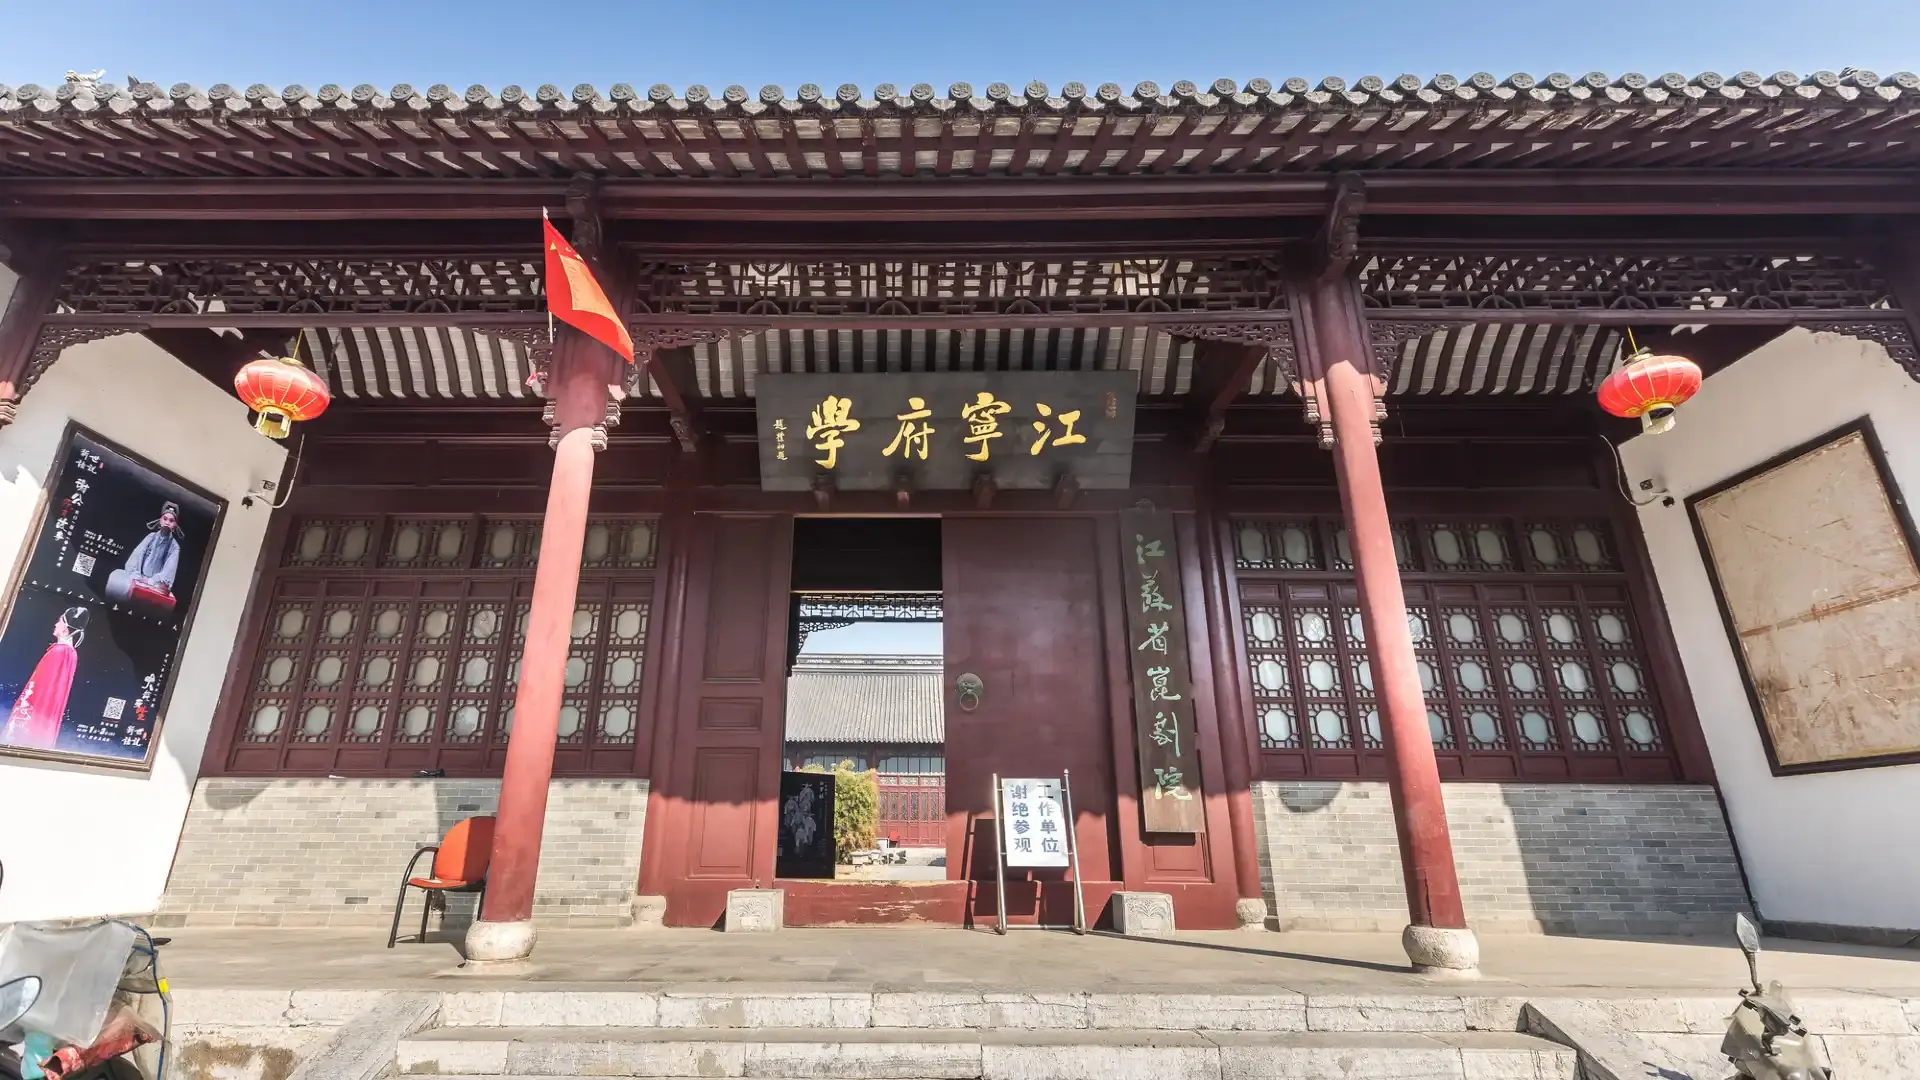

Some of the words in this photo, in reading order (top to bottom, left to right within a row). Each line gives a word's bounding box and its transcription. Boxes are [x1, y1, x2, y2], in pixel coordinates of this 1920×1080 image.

[1010, 784, 1032, 853] 谢绝参观
[1037, 784, 1060, 853] 工作单位
